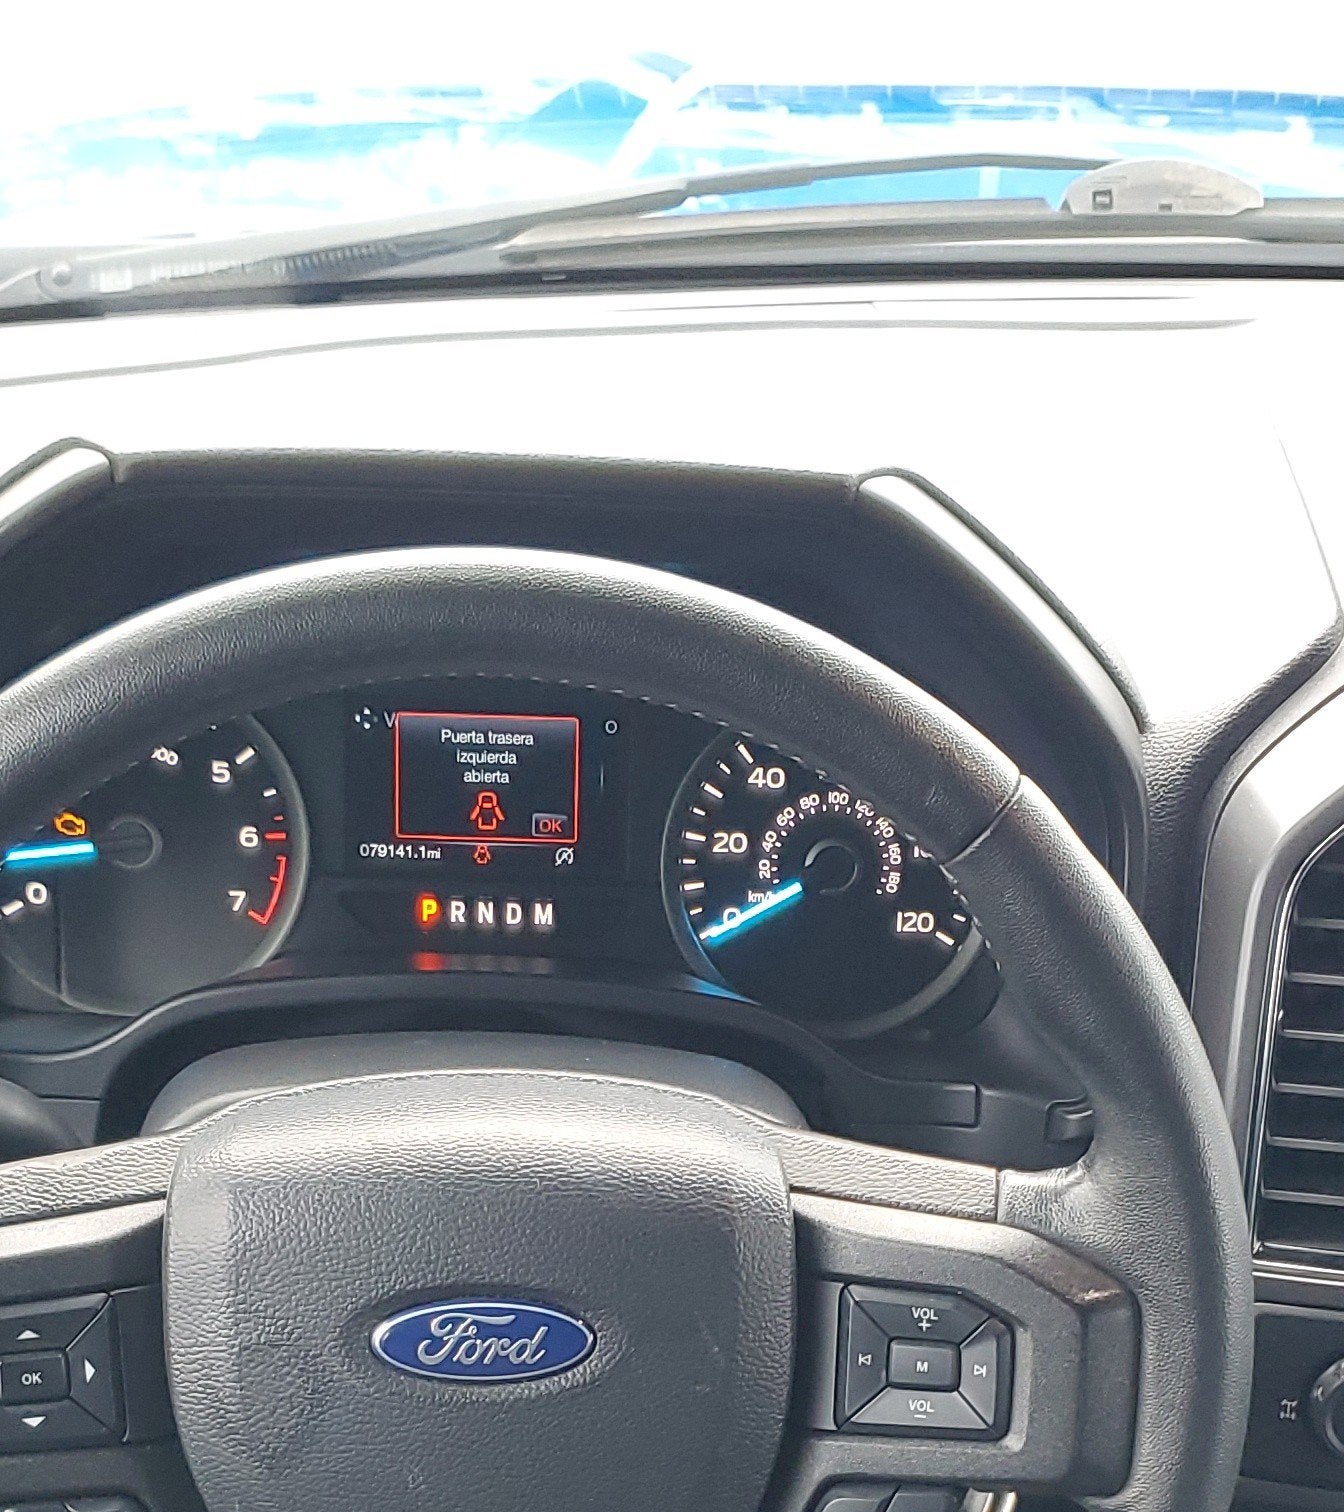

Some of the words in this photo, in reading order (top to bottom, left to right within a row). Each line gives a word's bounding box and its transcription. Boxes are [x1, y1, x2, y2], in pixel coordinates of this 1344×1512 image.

[441, 728, 484, 745] Puerta
[488, 731, 534, 746] trasera
[211, 760, 231, 783] 5
[463, 769, 510, 785] abierta
[747, 767, 786, 789] 40
[799, 793, 820, 810] 80
[828, 791, 850, 805] 100
[539, 819, 563, 833] OK
[775, 806, 796, 828] 60
[238, 826, 258, 848] 6
[711, 832, 749, 854] 20
[761, 830, 777, 853] 40
[758, 859, 772, 880] 20
[25, 881, 47, 905] 0
[228, 890, 246, 912] 7
[421, 898, 438, 922] P
[450, 901, 466, 923] R
[478, 902, 494, 924] N
[506, 902, 522, 925] D
[534, 903, 553, 925] M
[896, 911, 935, 933] 120
[911, 1306, 939, 1321] VOL
[417, 1312, 549, 1366] Ford
[916, 1361, 929, 1373] M
[21, 1371, 44, 1386] OK
[908, 1399, 935, 1413] VOL
